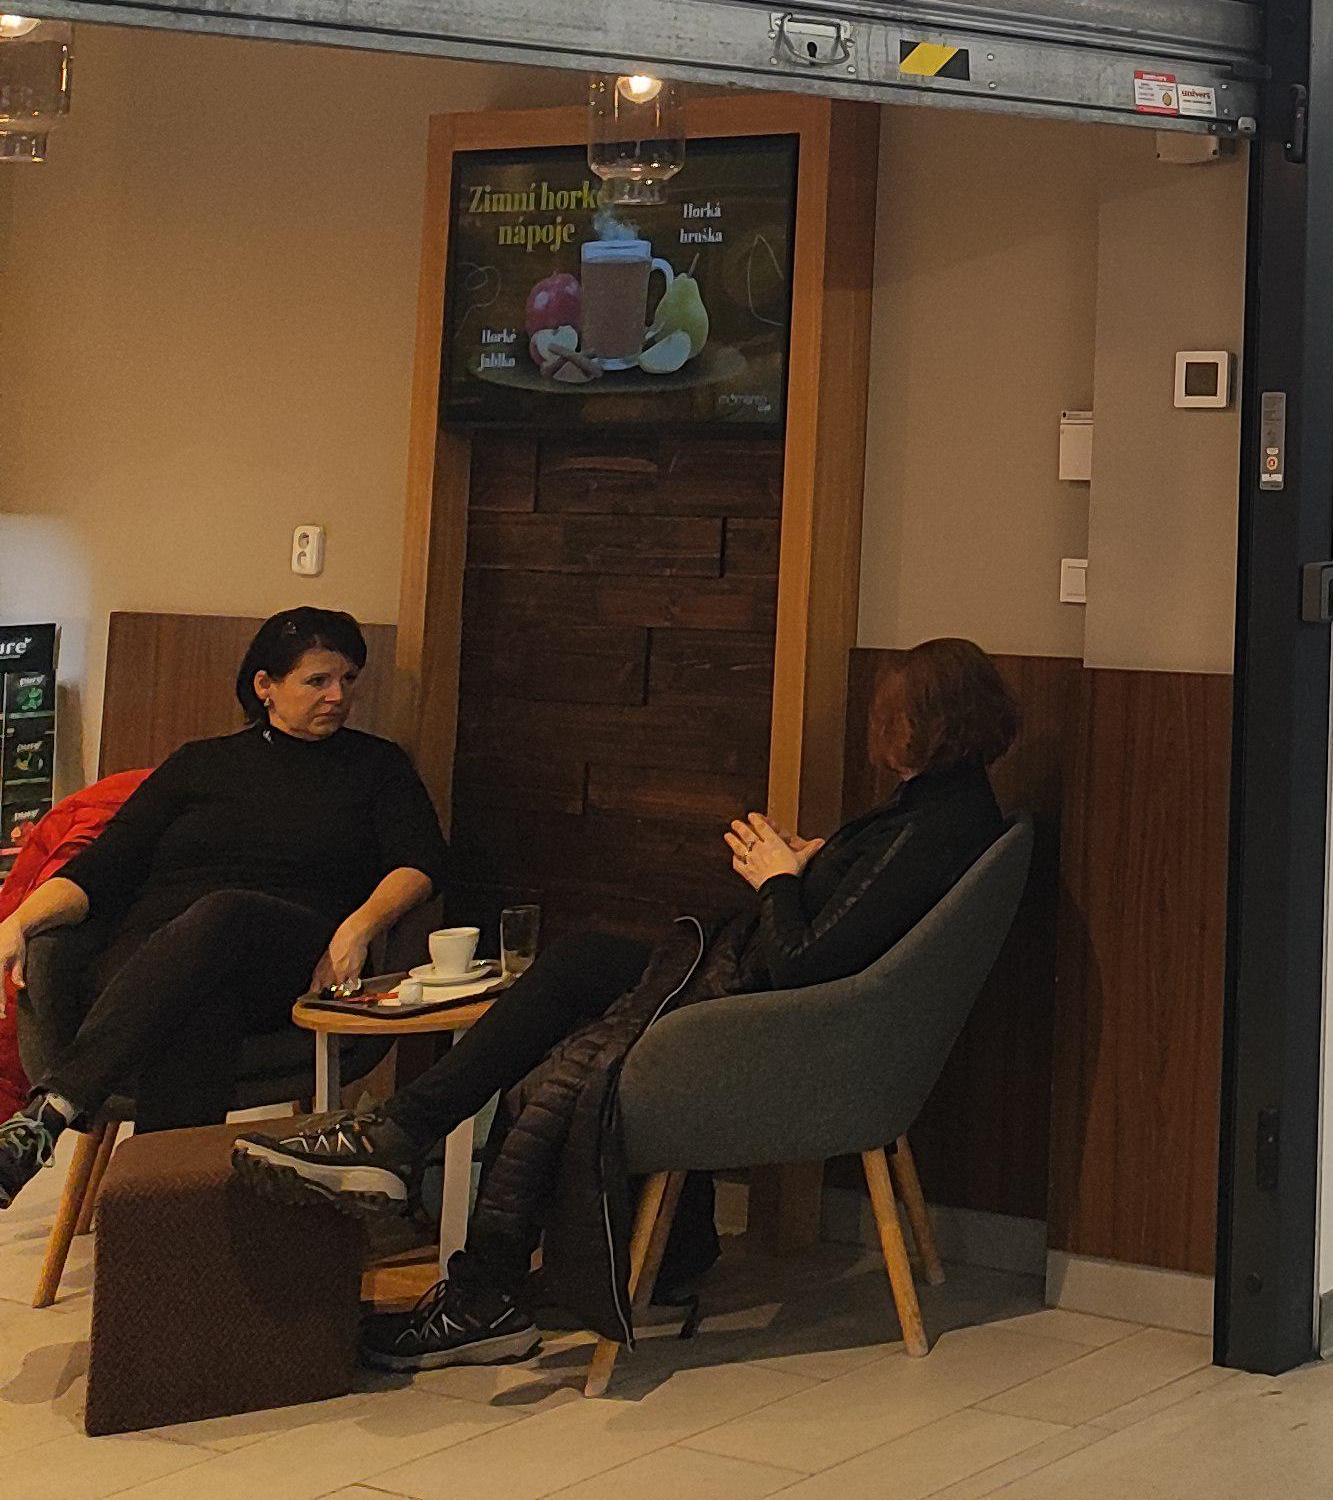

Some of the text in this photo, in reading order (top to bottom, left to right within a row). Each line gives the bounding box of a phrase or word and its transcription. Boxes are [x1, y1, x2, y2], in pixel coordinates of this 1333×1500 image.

[469, 182, 536, 213] Zimní
[683, 201, 721, 219] Horká
[498, 216, 576, 251] nápoje
